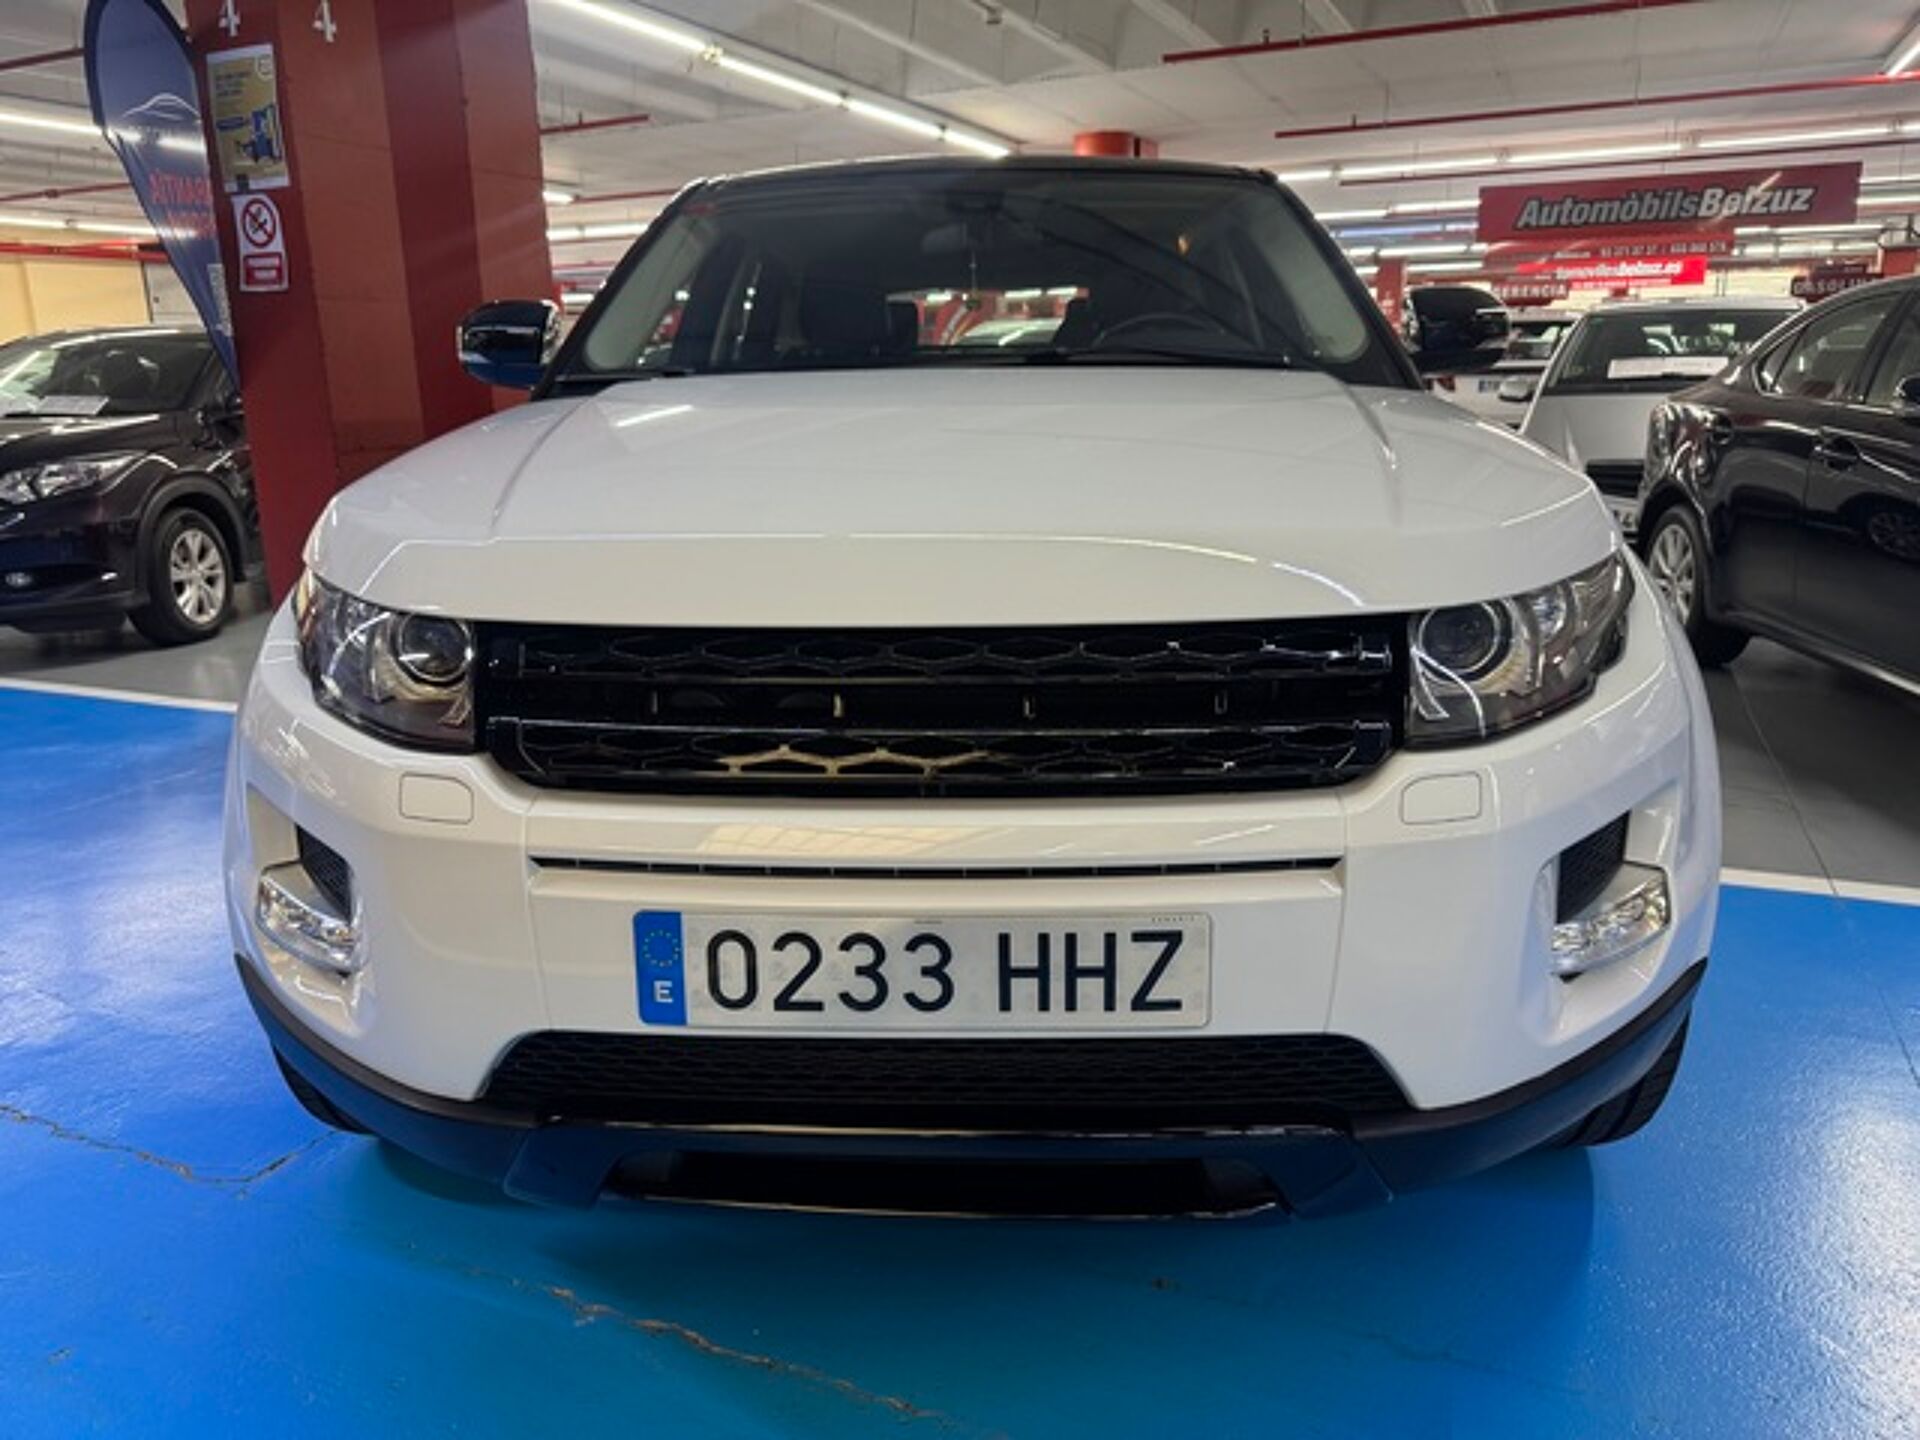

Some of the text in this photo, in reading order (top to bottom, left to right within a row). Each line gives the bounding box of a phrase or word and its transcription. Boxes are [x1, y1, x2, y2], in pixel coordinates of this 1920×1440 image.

[219, 0, 240, 37] 4
[312, 0, 337, 42] 4
[706, 930, 1183, 1012] 0233 HHZ
[654, 980, 673, 1003] E
